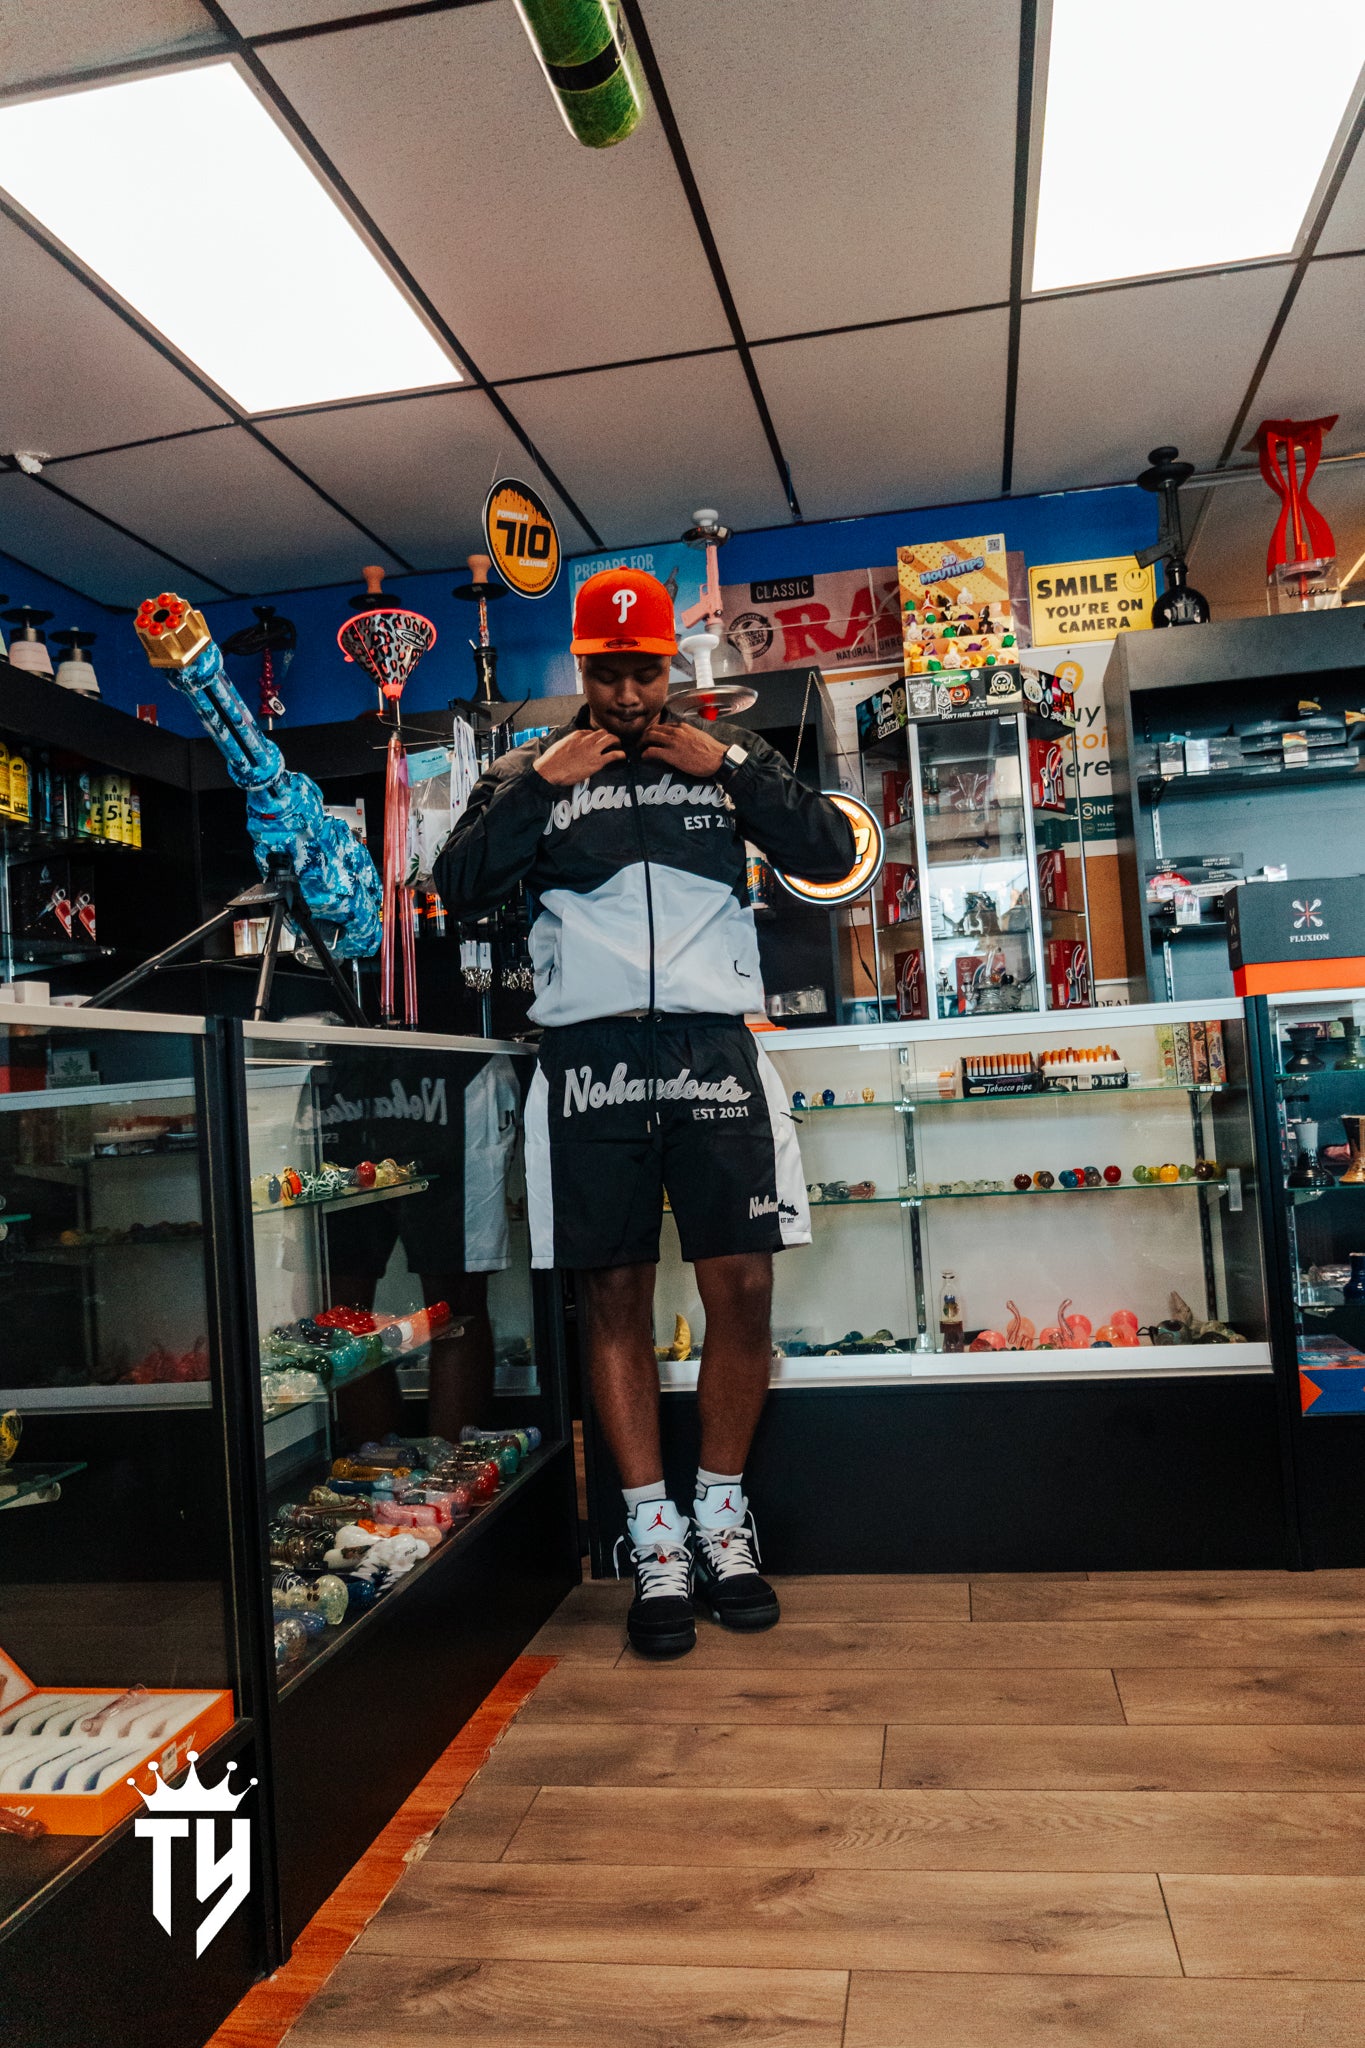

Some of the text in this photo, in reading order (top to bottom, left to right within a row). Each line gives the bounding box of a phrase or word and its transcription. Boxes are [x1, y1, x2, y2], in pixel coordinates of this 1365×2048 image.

[496, 519, 551, 560] 710
[630, 553, 654, 569] FOR
[941, 554, 958, 567] 3D
[920, 556, 985, 585] MOUTHTIPS
[755, 580, 810, 601] CLASSIC
[1036, 573, 1118, 599] SMILE
[611, 588, 638, 624] P
[1045, 598, 1143, 619] YOU'RE ON
[1058, 616, 1131, 634] CAMERA
[836, 646, 874, 661] NATURAL
[1074, 705, 1102, 728] uy
[1064, 759, 1110, 778] ere
[683, 815, 711, 831] EST
[1289, 933, 1330, 943] FLUXION
[563, 1062, 752, 1118] Nohandouts
[982, 1083, 1015, 1094] Tobacco
[1016, 1082, 1033, 1093] pipe
[692, 1106, 749, 1121] EST 2021
